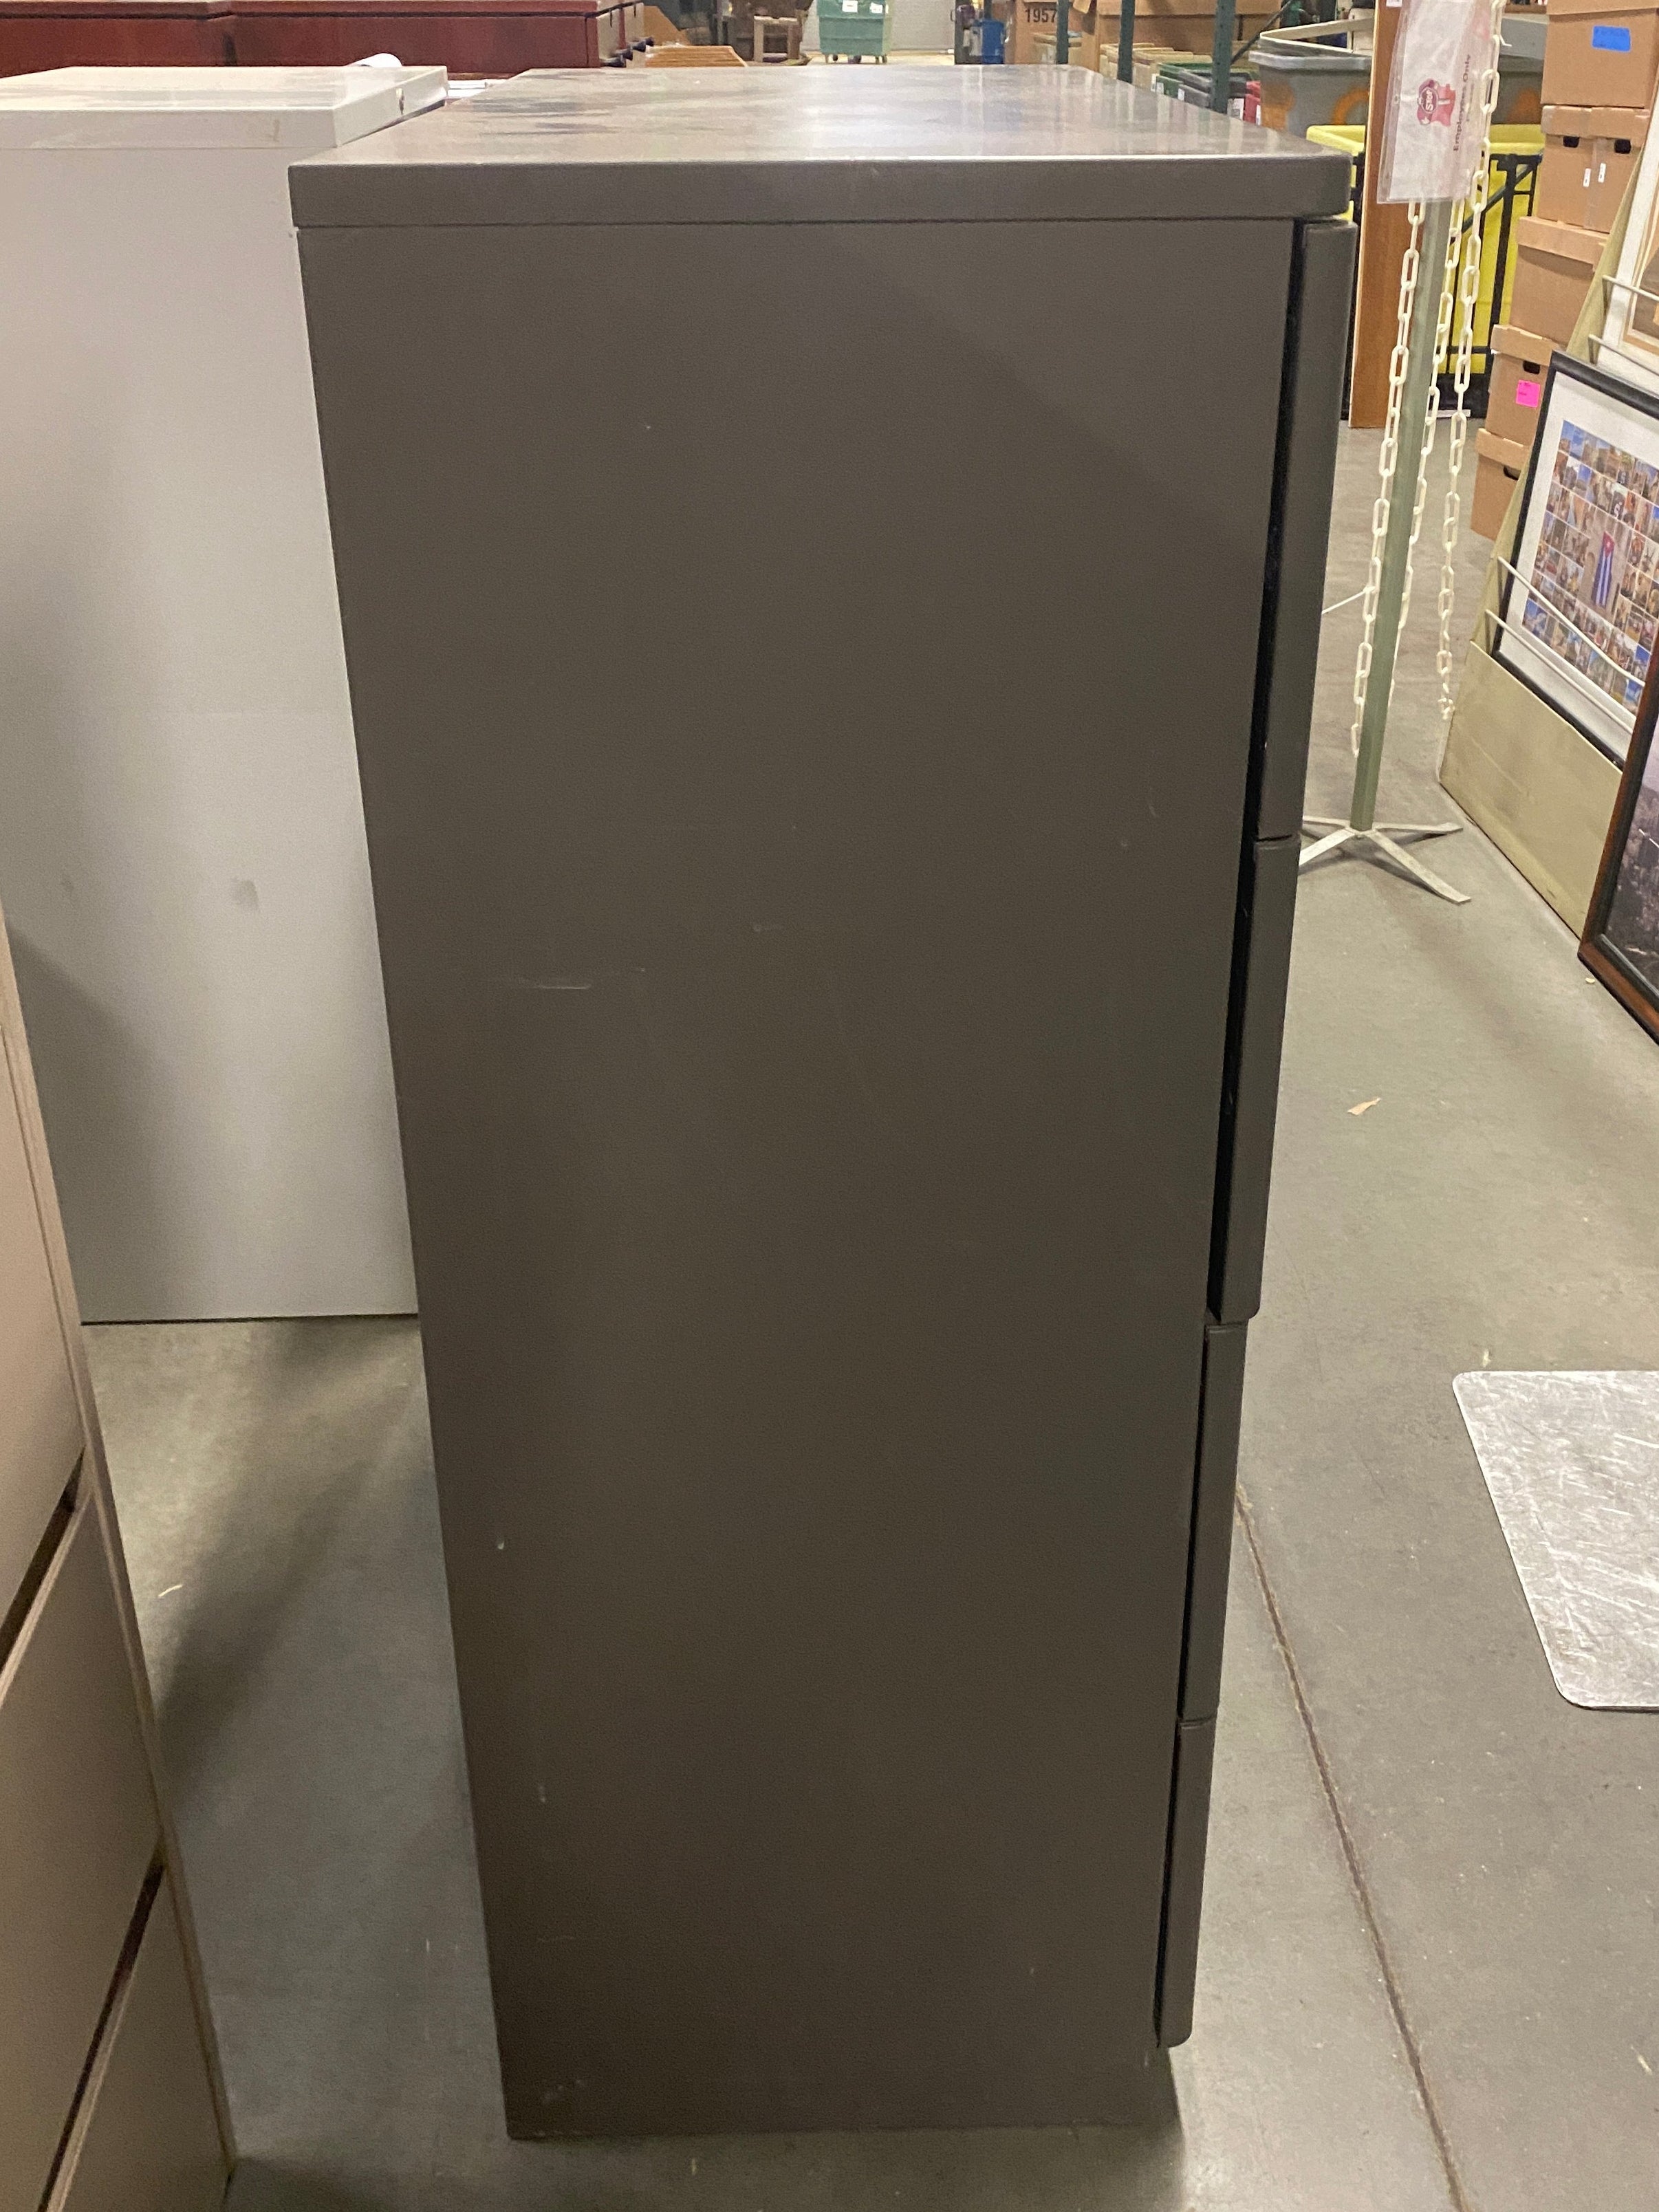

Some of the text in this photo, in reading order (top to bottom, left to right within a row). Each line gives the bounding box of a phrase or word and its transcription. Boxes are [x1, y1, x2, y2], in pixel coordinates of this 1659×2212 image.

[1025, 8, 1057, 23] 1957
[1462, 54, 1471, 83] Only
[1425, 89, 1434, 111] STOP
